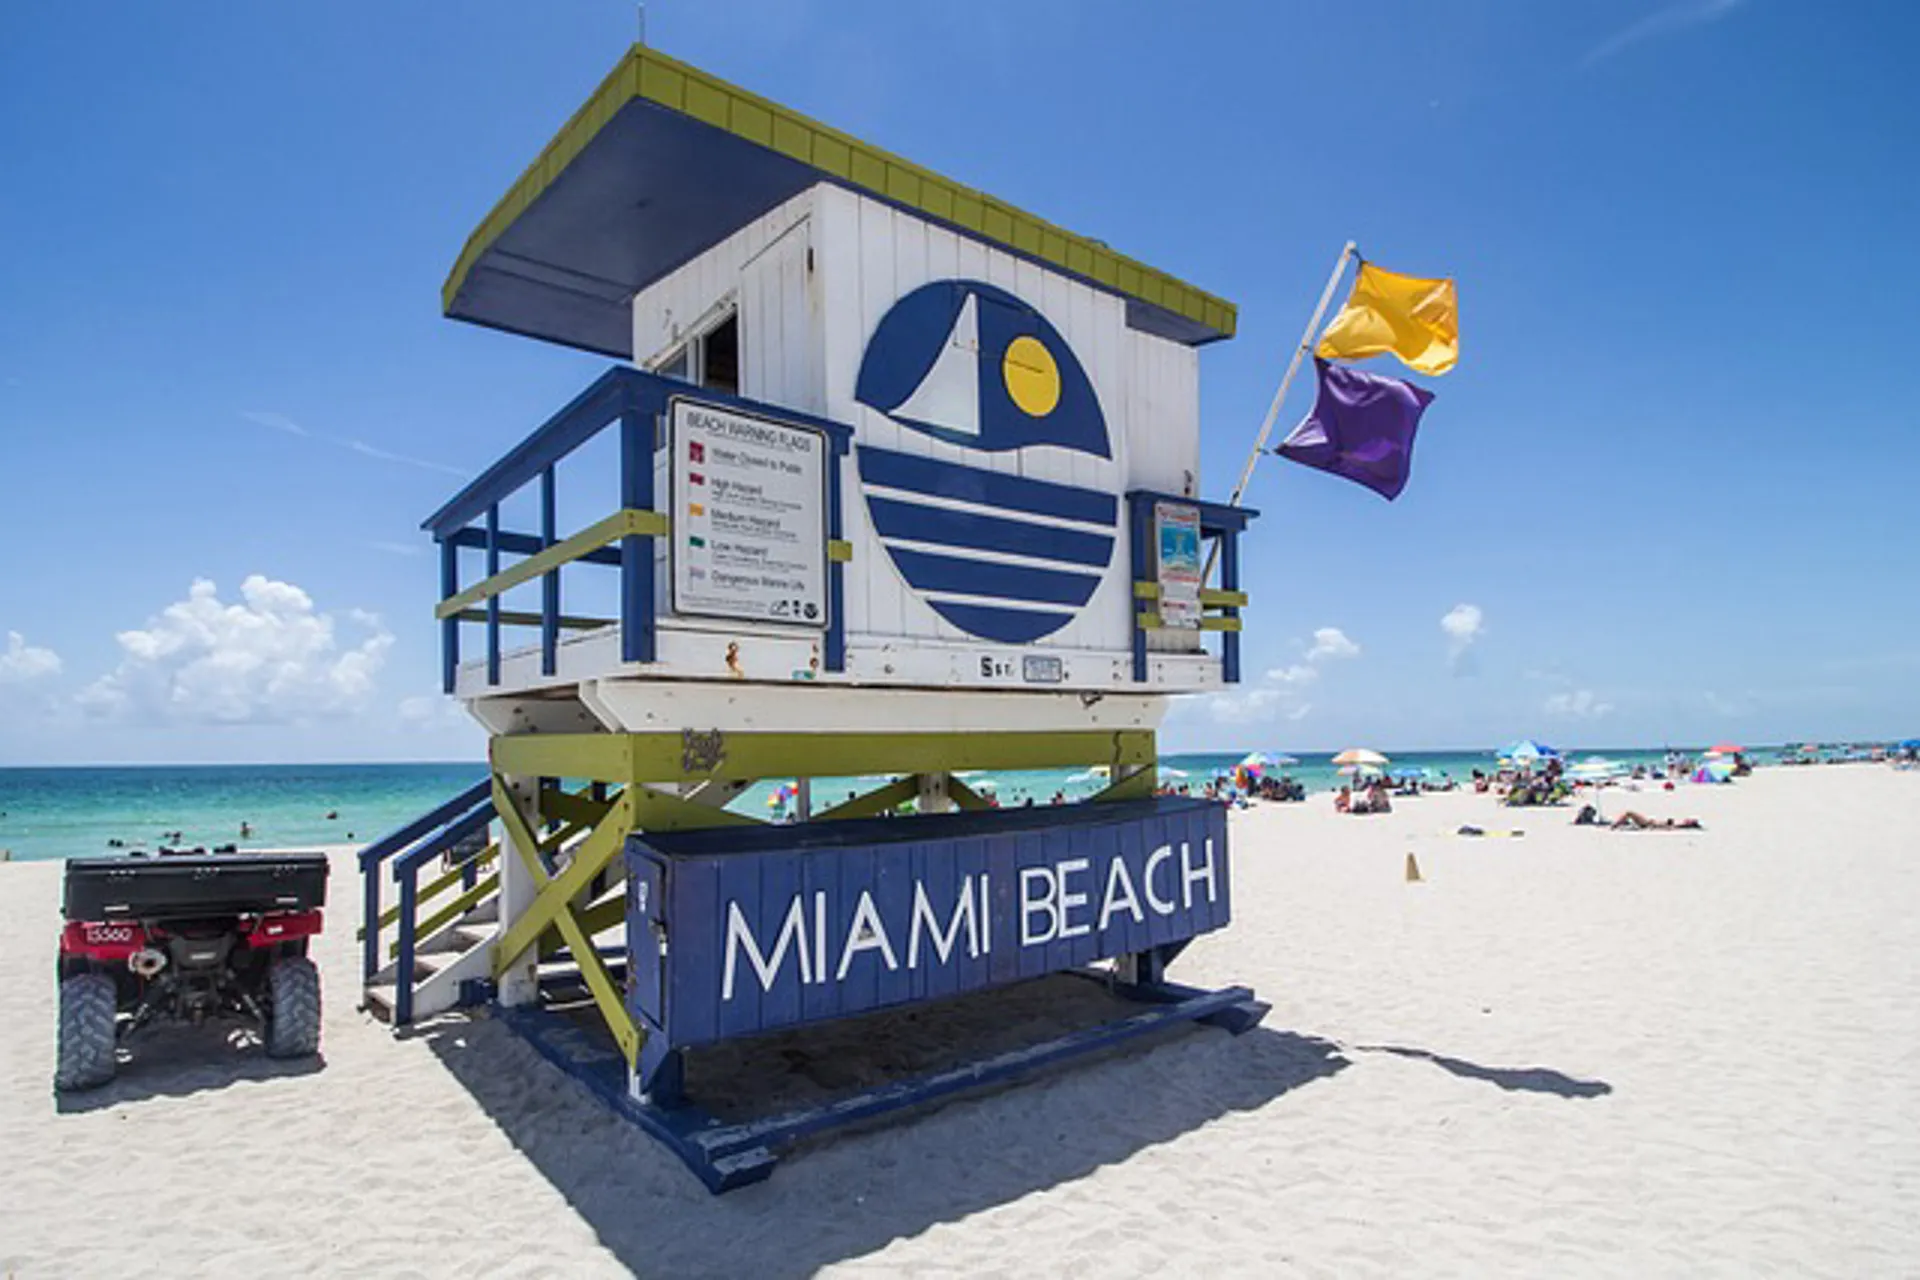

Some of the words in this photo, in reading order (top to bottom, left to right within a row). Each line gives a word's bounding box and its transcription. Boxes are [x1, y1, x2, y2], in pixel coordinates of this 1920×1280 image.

[687, 412, 726, 431] BEACH
[722, 873, 991, 1000] MIAMI
[1020, 839, 1217, 946] BEACH
